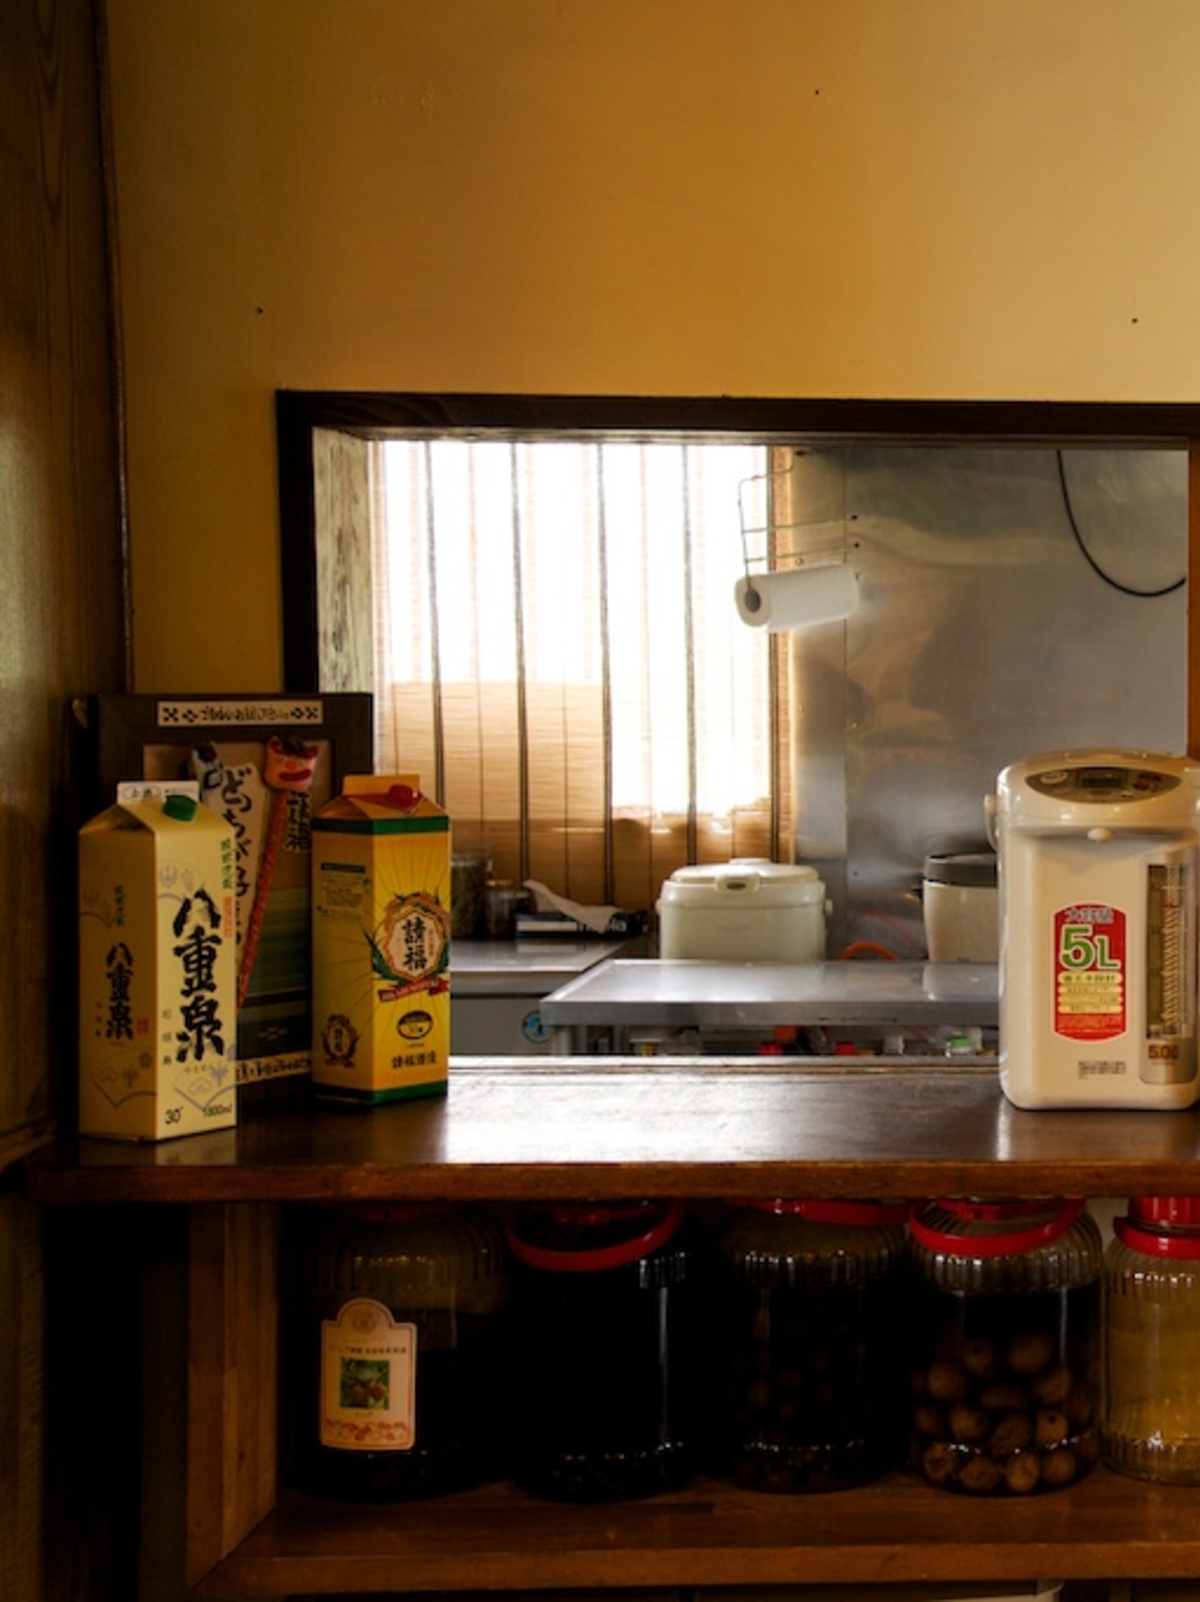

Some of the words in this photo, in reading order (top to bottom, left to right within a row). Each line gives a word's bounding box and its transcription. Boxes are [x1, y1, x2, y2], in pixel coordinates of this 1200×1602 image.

[105, 942, 134, 1040] 八重泉
[173, 884, 225, 1063] 八重泉
[1060, 924, 1121, 972] 5L
